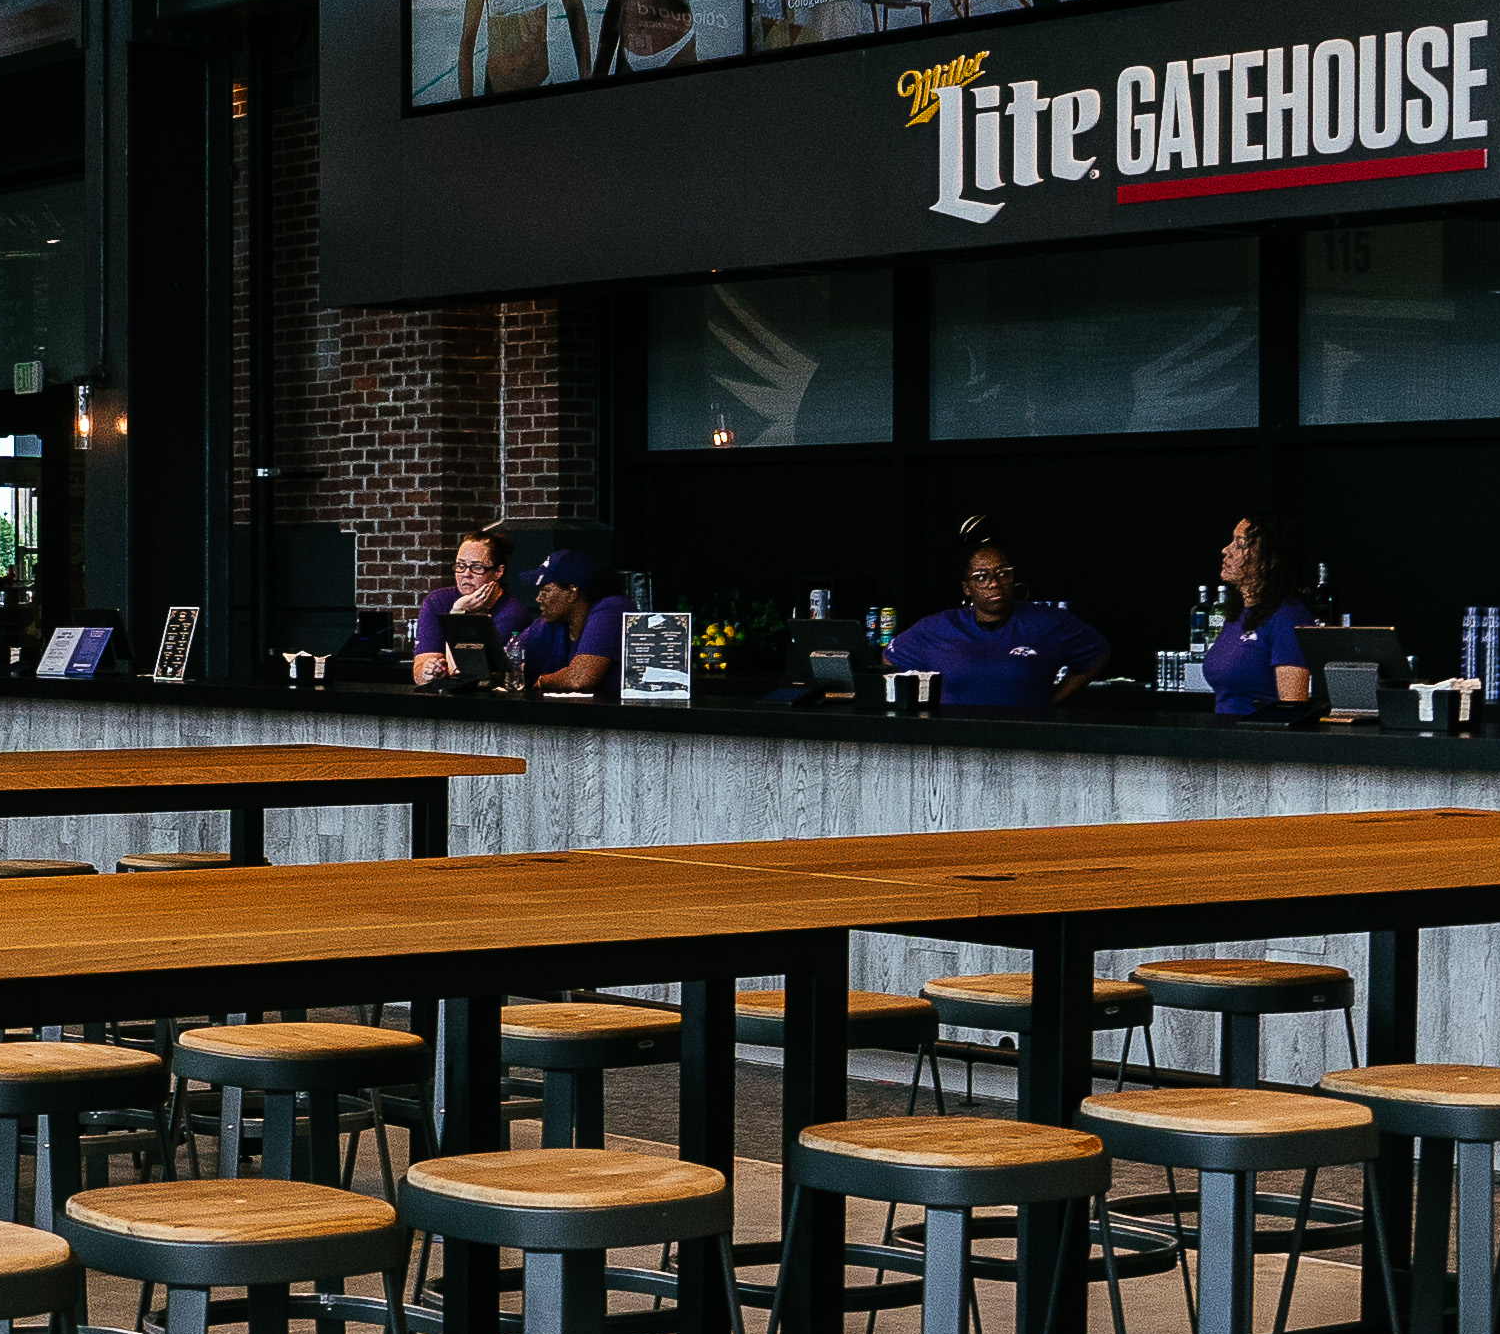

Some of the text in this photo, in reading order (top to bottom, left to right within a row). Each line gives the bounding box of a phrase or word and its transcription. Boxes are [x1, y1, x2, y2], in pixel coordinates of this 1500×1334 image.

[897, 50, 990, 120] Miller
[929, 18, 1490, 224] Lite GATEHOUSE
